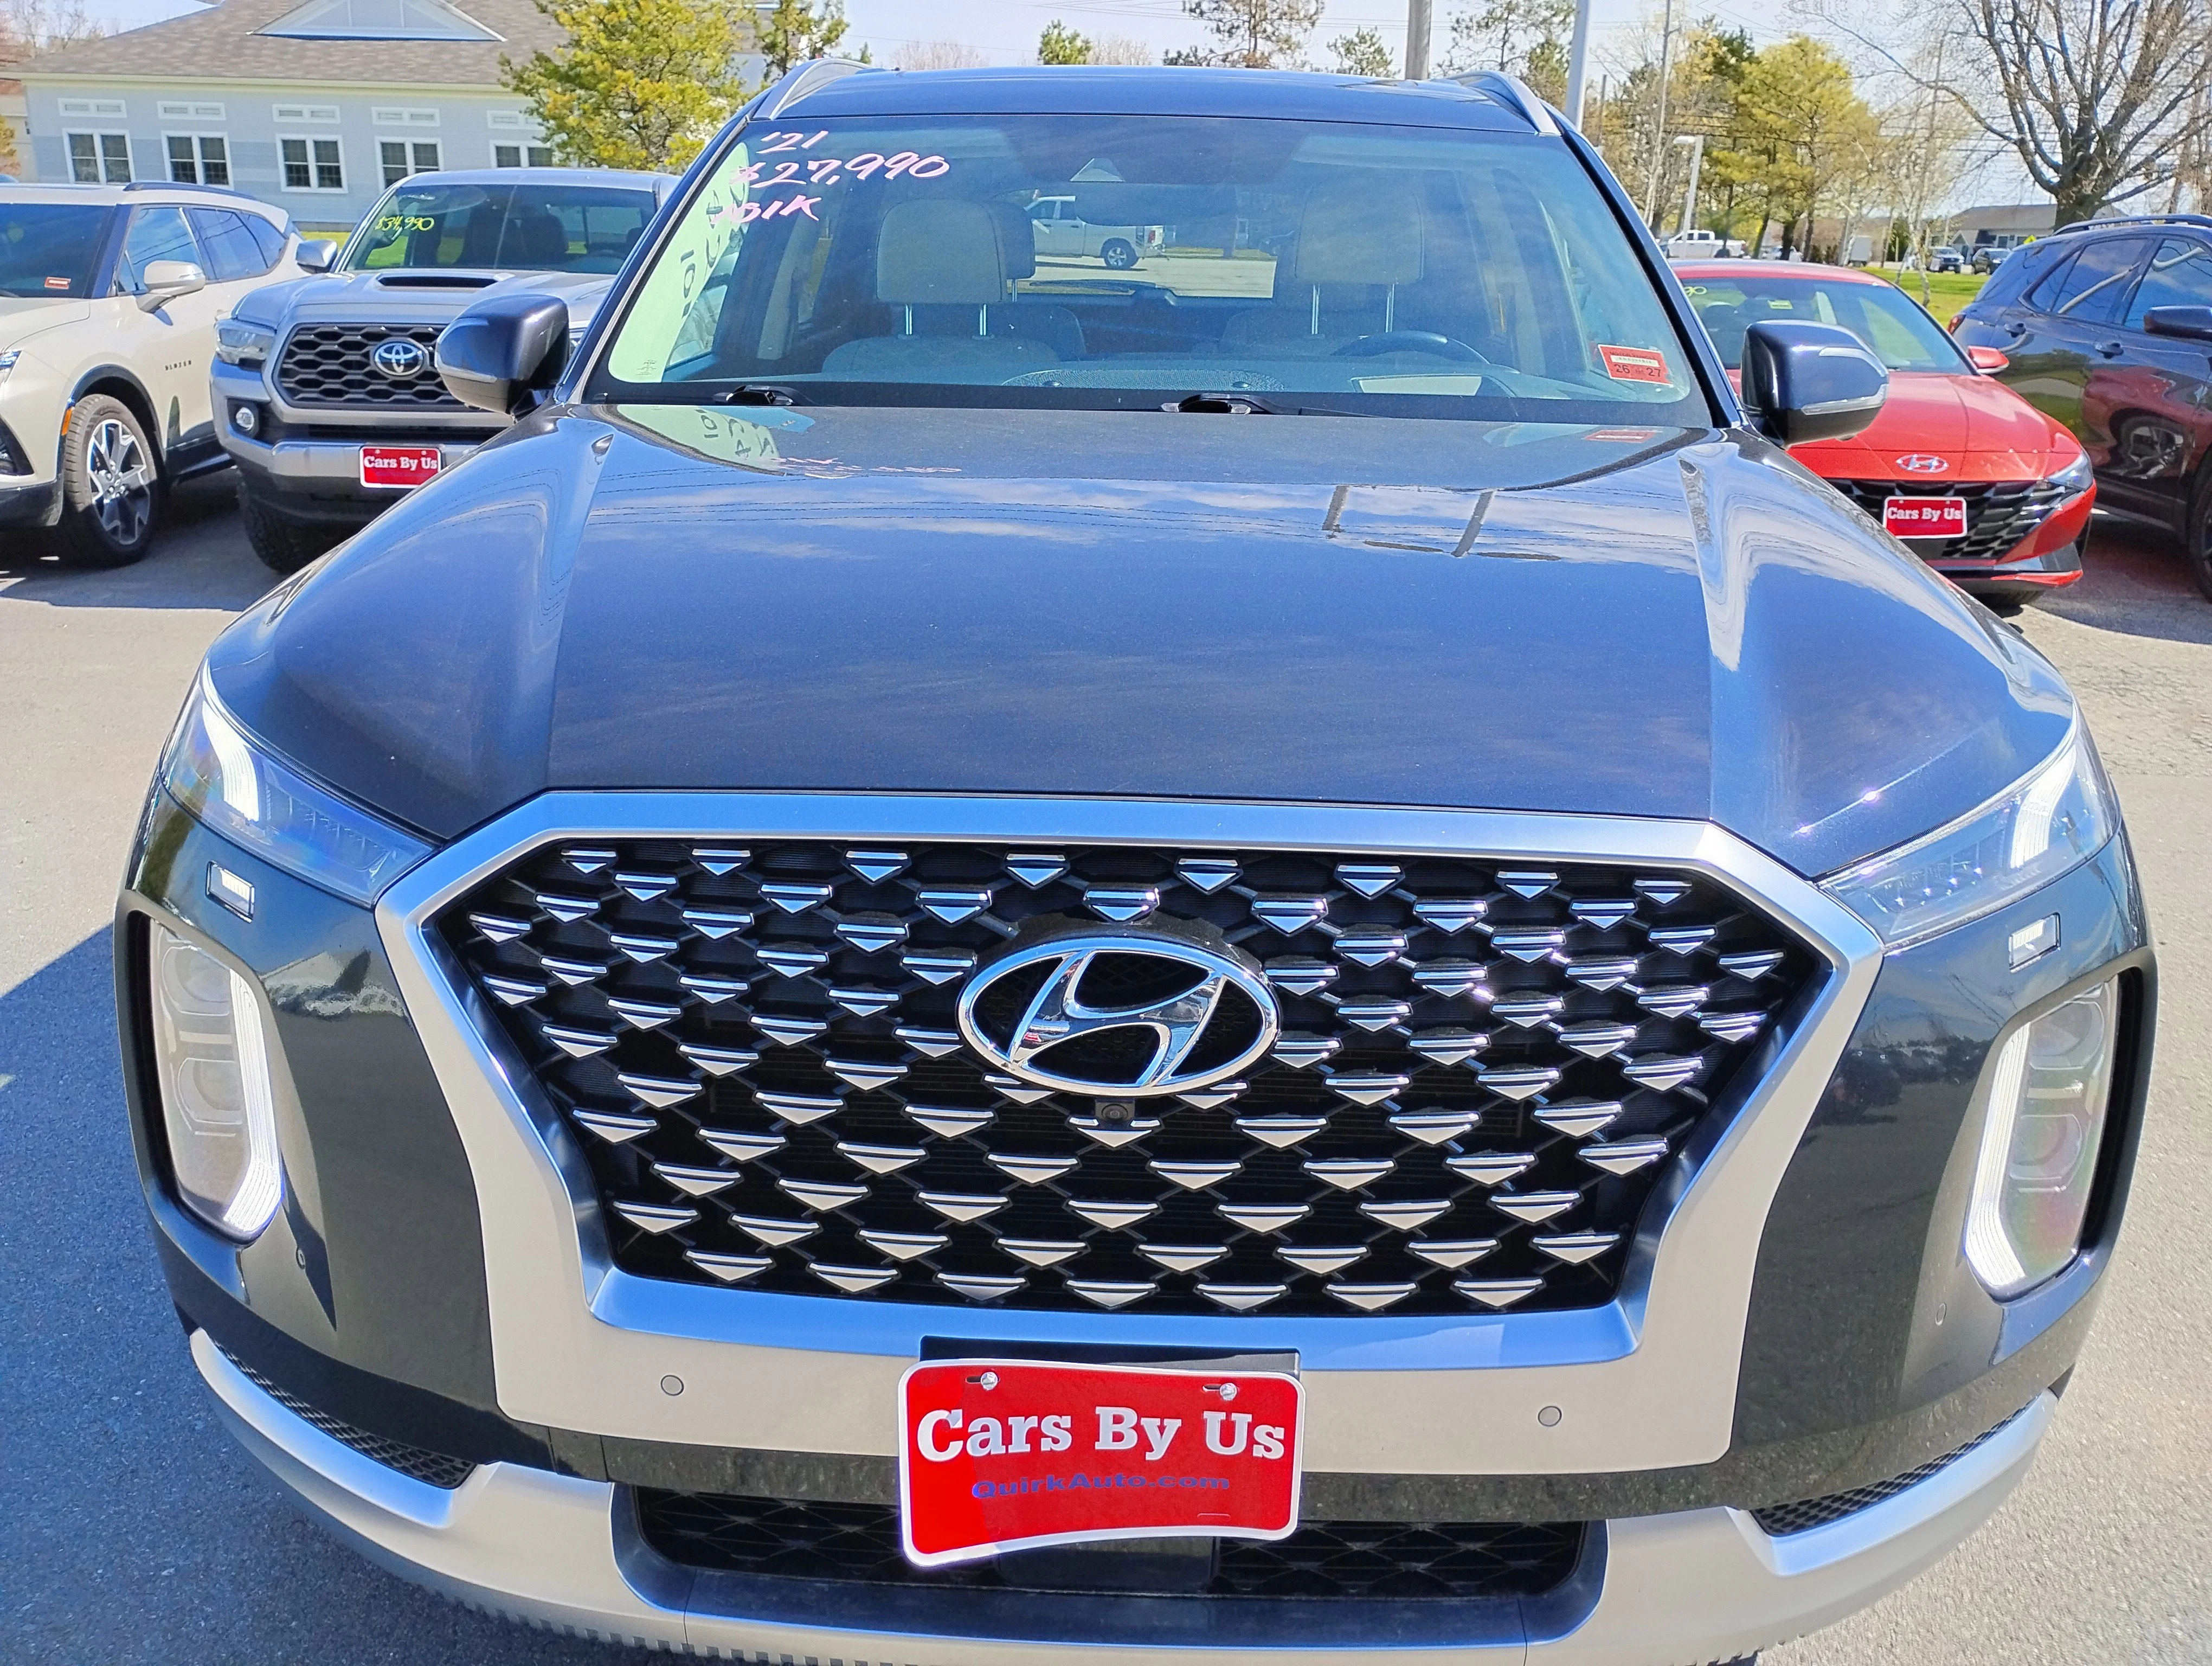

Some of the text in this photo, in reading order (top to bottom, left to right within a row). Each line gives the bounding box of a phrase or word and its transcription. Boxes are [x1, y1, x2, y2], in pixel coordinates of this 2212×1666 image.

[728, 151, 950, 188] $27,990
[375, 215, 435, 232] $34,990
[1646, 367, 1661, 377] 27
[364, 456, 438, 471] Cars By Us
[1888, 507, 1963, 522] Cars By Us
[917, 1406, 1285, 1463] Cars By Us
[972, 1472, 1230, 1498] QuirkAuto.com
